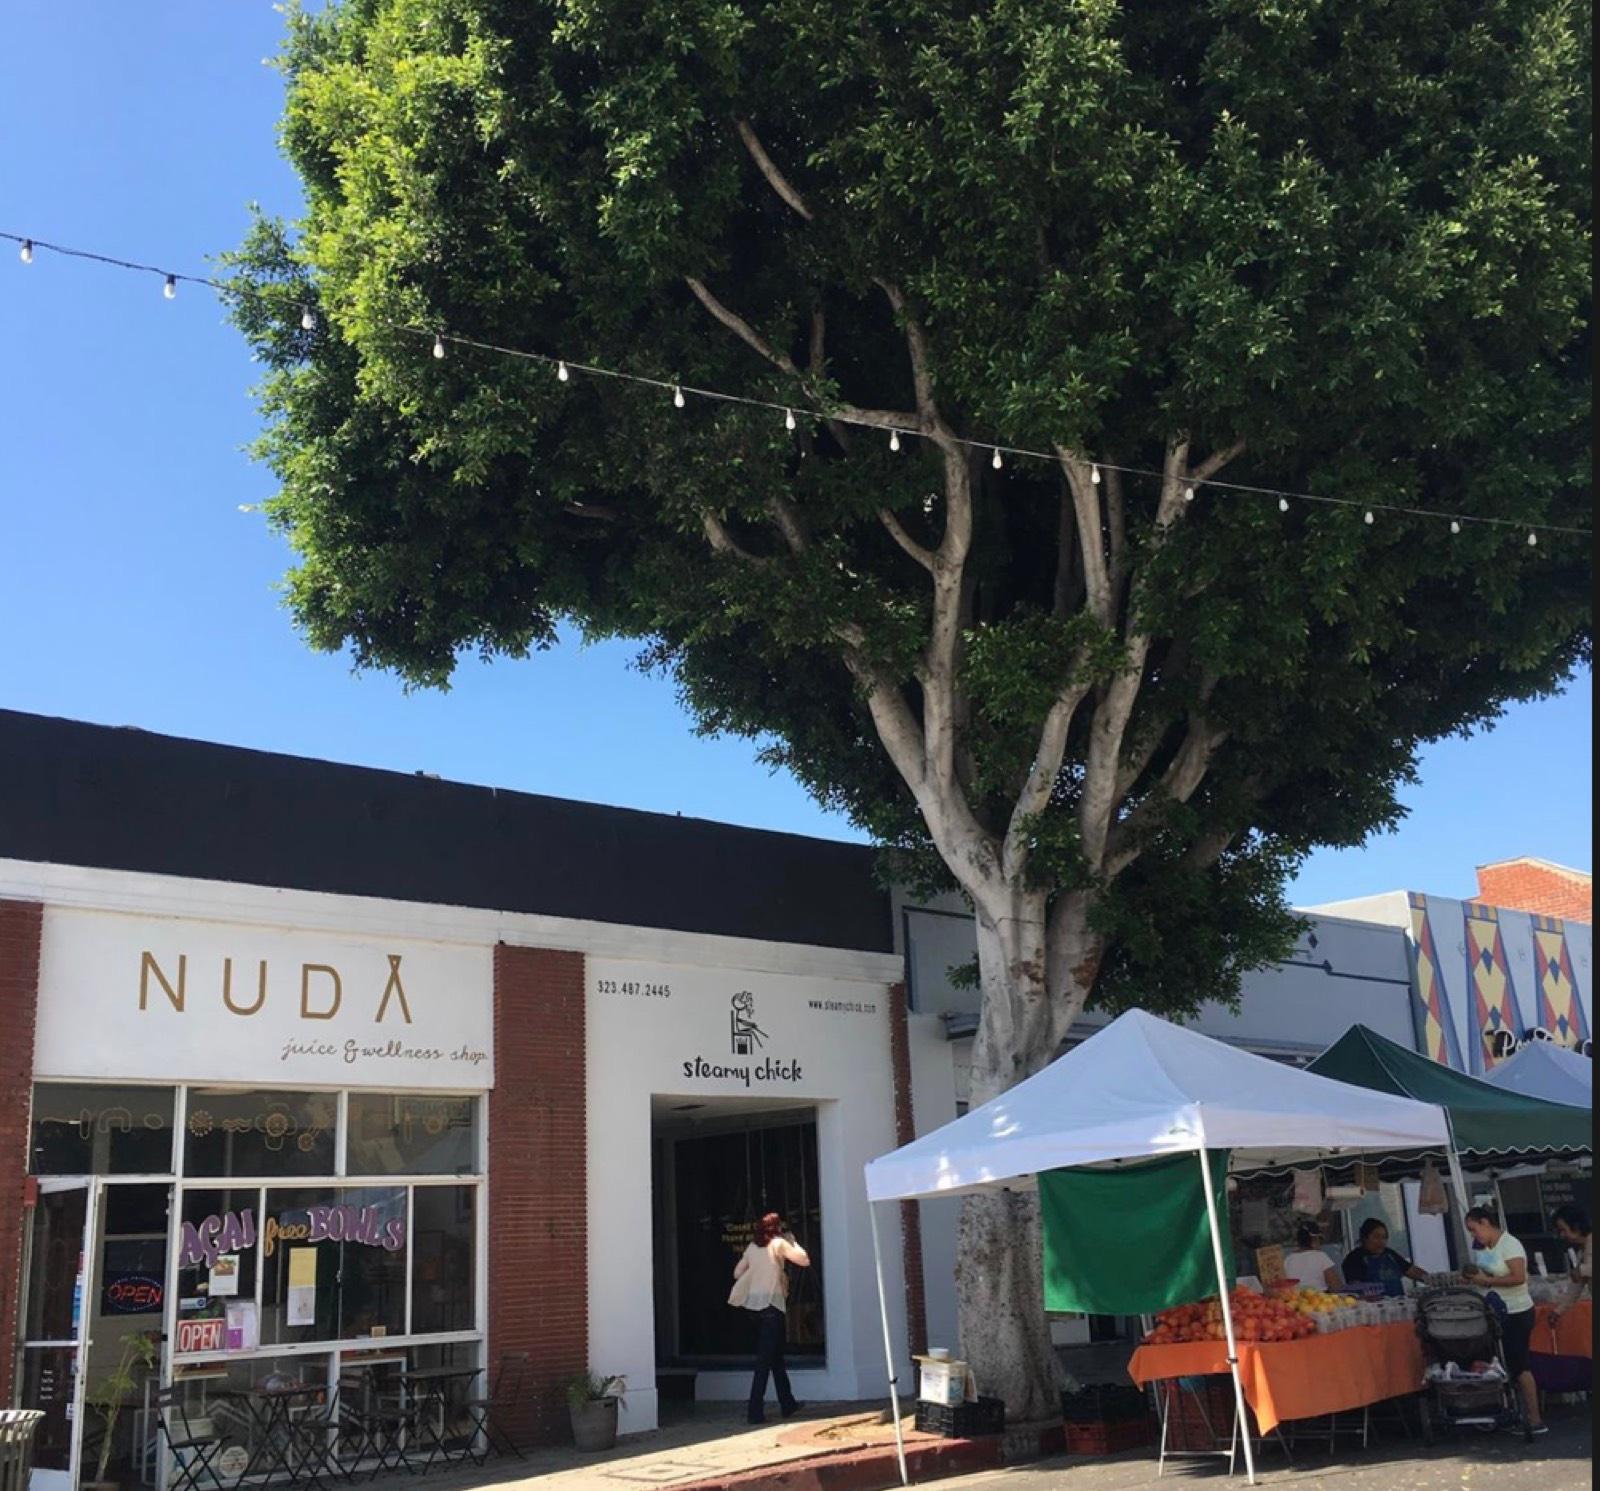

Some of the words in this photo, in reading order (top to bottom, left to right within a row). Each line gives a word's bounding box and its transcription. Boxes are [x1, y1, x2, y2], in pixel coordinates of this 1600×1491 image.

[281, 1038, 338, 1060] juice
[362, 1040, 444, 1060] wellness
[450, 1045, 488, 1065] shop
[683, 1055, 750, 1087] steamy
[754, 1056, 803, 1082] chick
[306, 1205, 405, 1251] BOWLS
[107, 1283, 163, 1305] OPEN
[181, 1322, 221, 1352] OPEN
